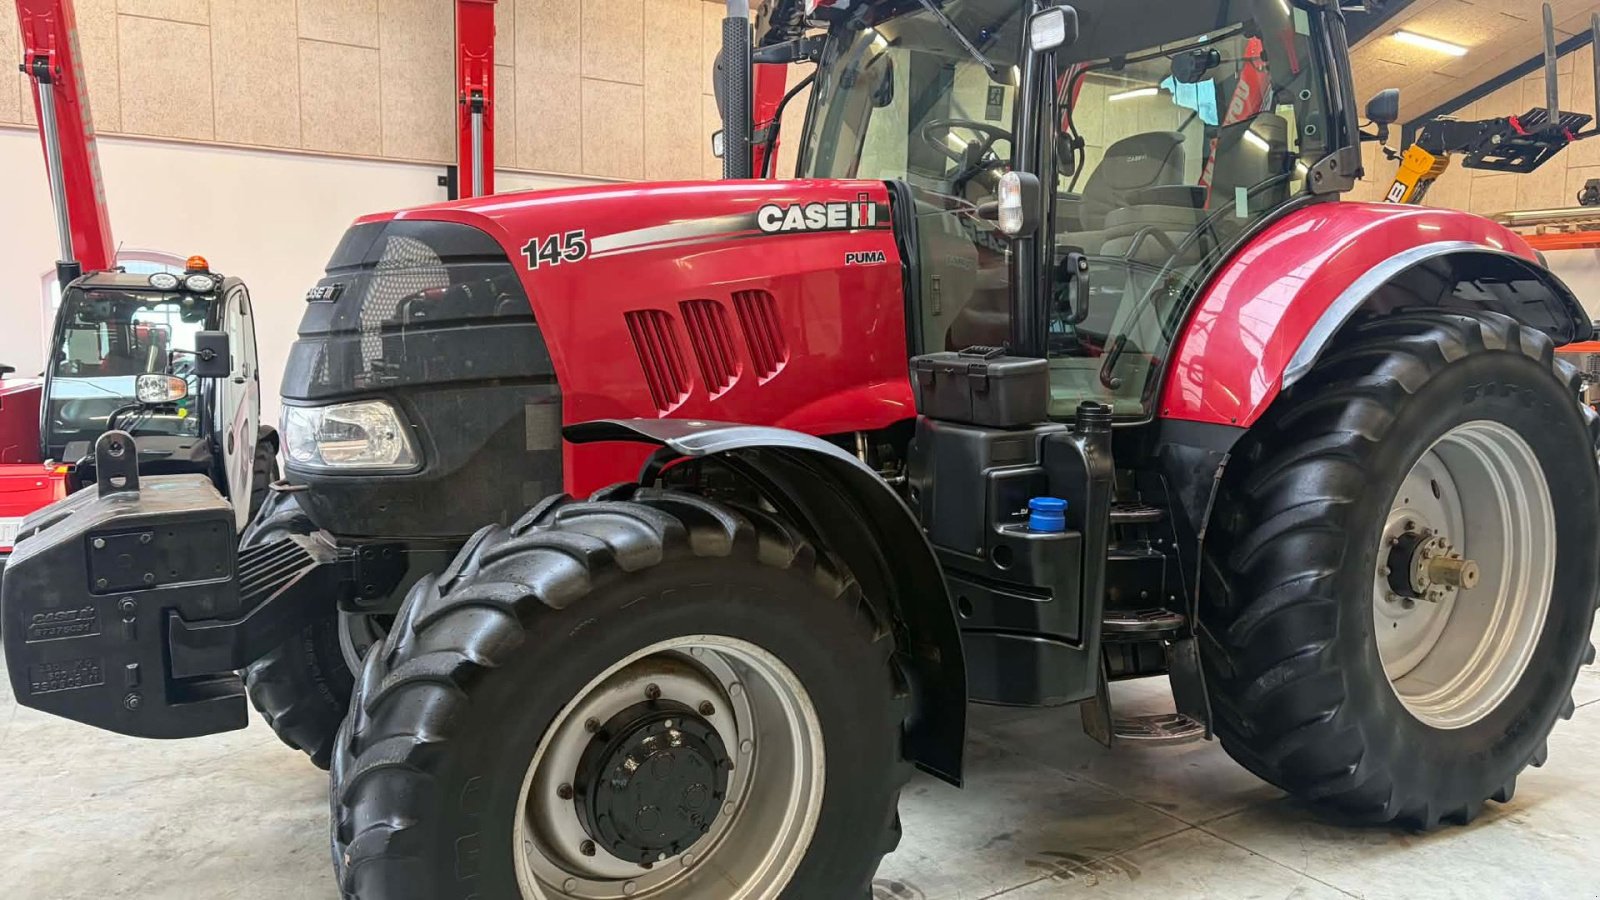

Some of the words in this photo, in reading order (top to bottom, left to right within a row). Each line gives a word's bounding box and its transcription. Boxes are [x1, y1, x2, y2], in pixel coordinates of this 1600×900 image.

[757, 201, 848, 233] CASE
[520, 229, 587, 271] 145
[844, 251, 886, 265] PUMA
